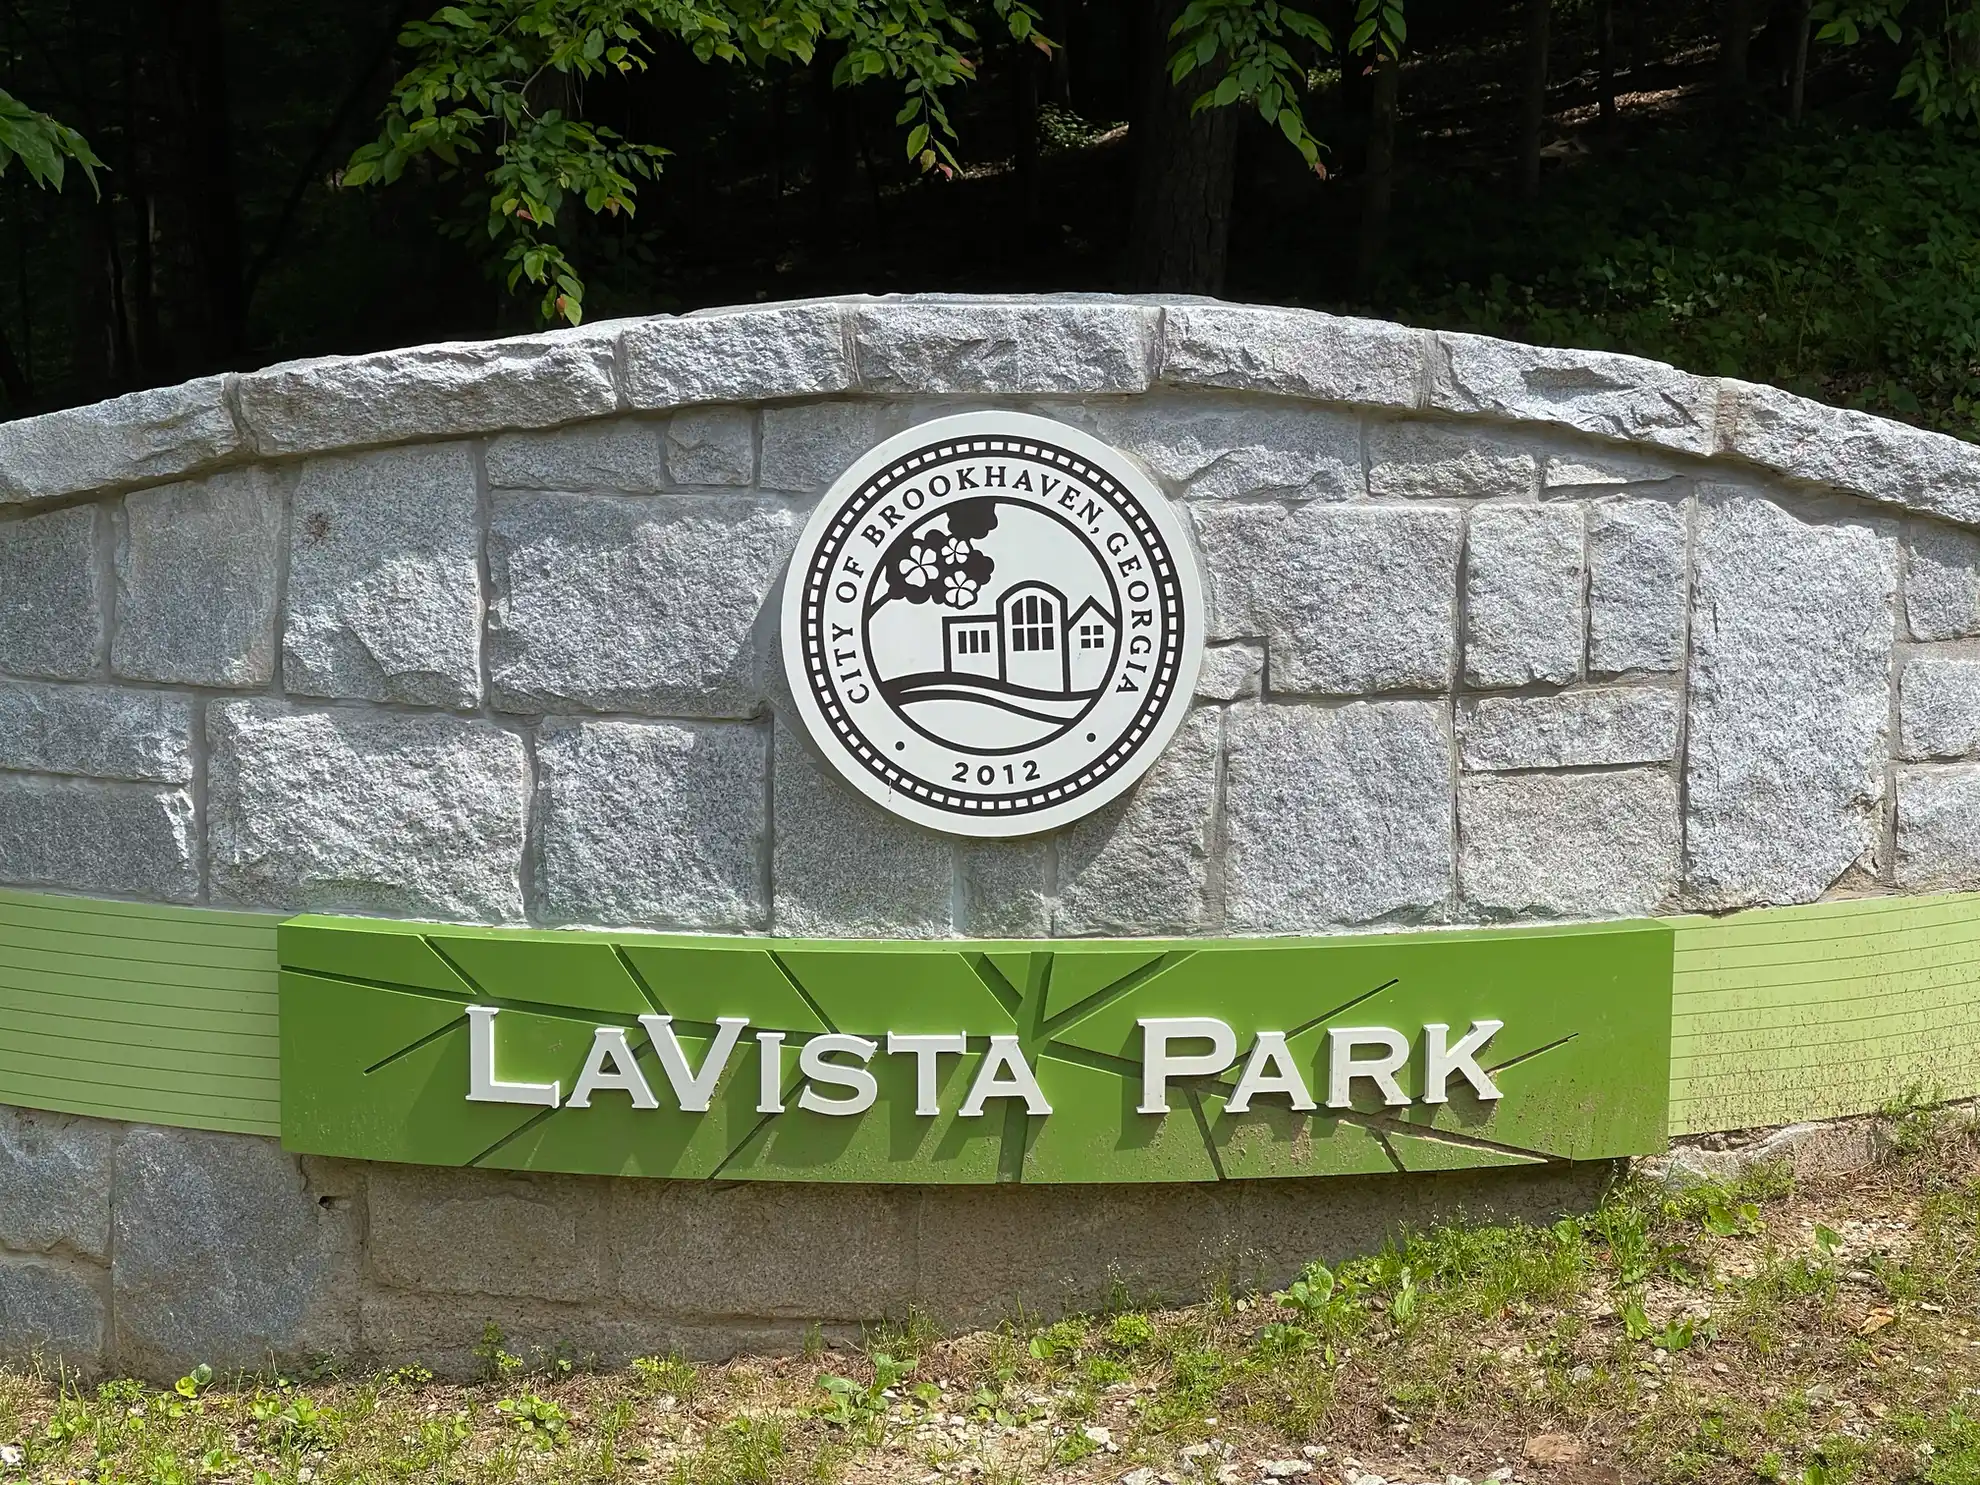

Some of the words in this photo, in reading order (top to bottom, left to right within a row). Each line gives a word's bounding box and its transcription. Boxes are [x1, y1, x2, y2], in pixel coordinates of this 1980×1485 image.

[860, 465, 1105, 548] BROOKHAVEN,
[837, 556, 865, 604] OF
[1106, 532, 1152, 695] GEORGIA
[832, 623, 869, 705] CITY
[951, 760, 1041, 785] 2012
